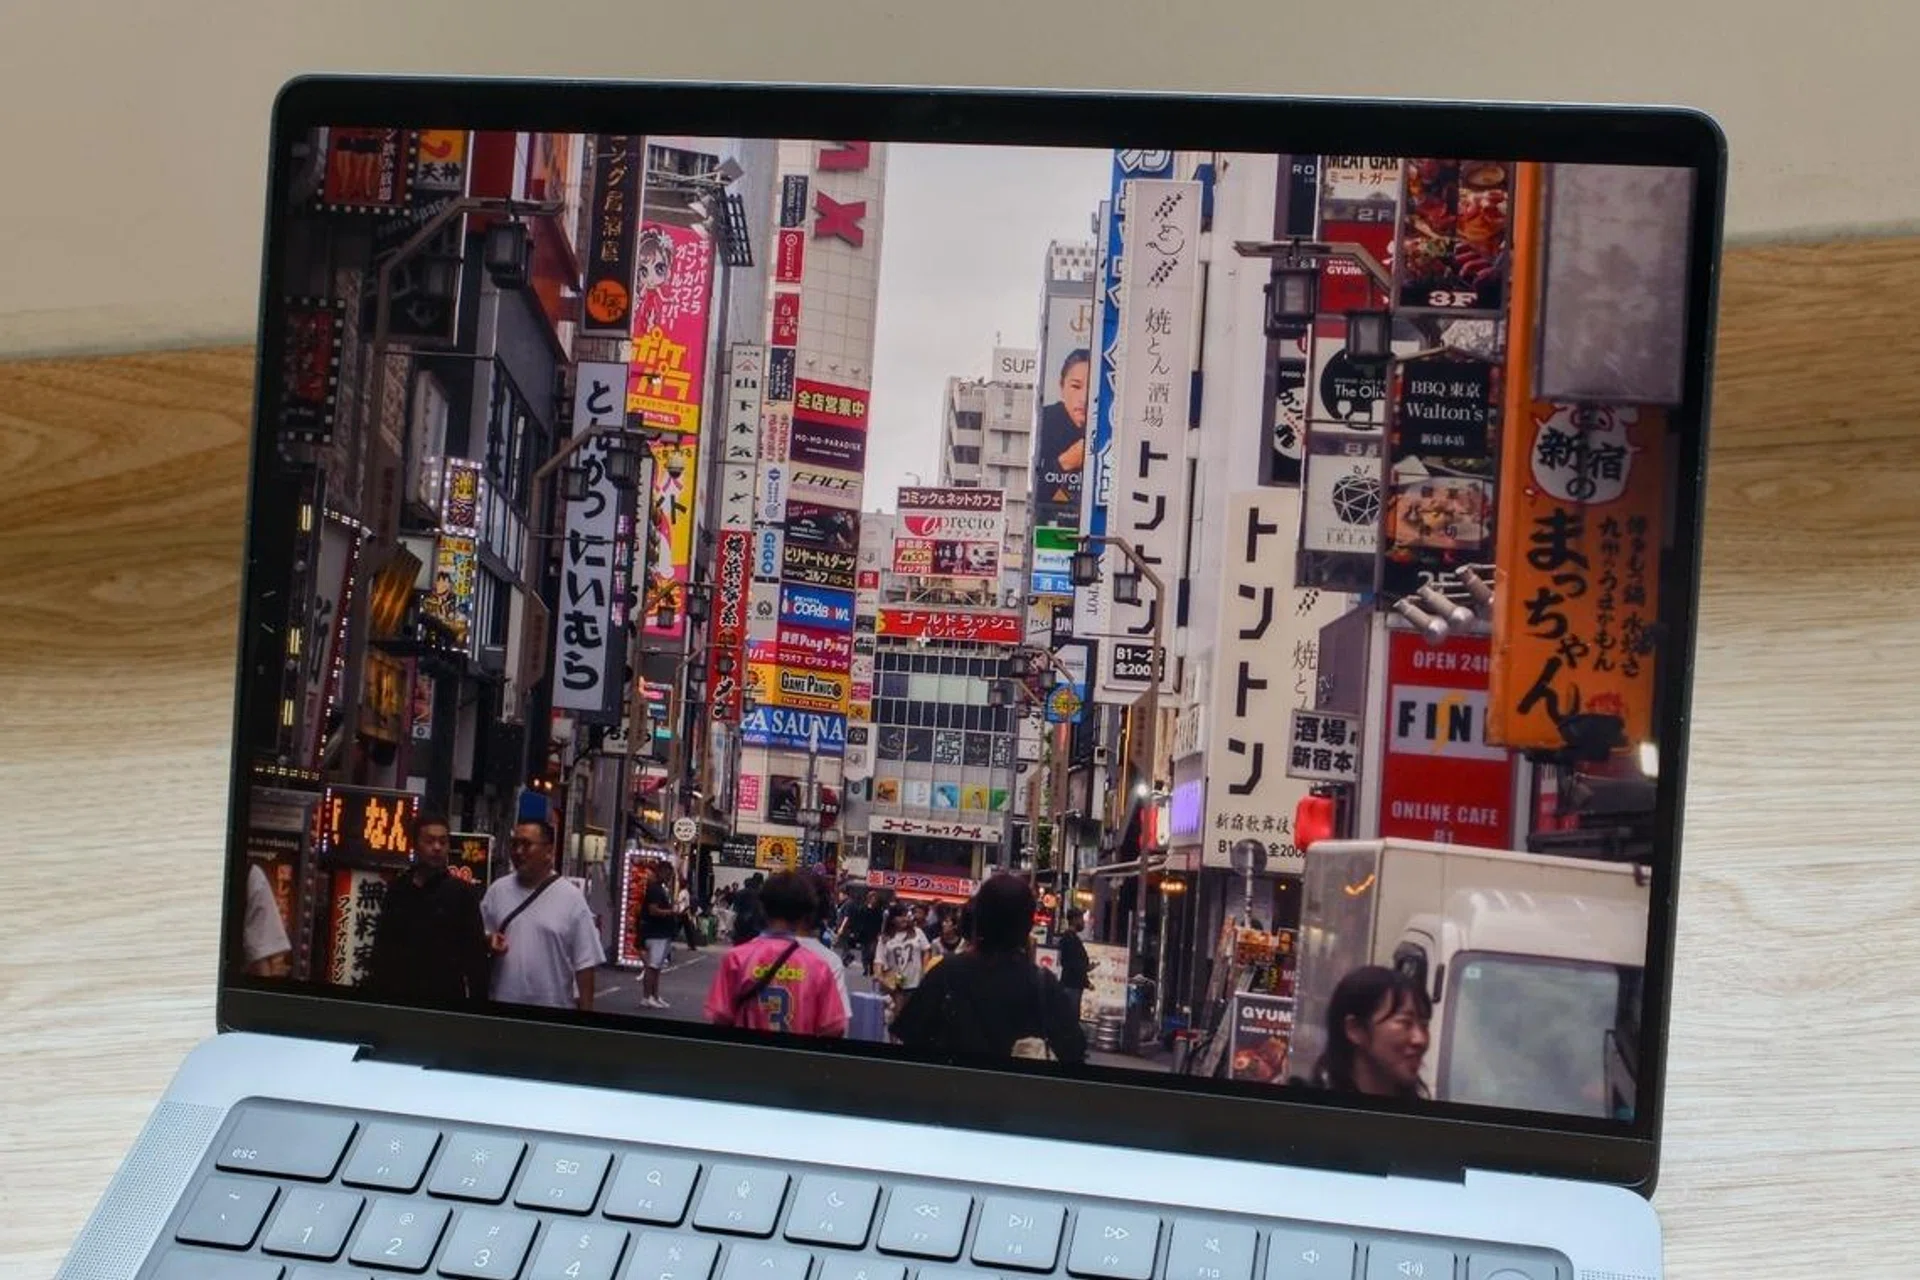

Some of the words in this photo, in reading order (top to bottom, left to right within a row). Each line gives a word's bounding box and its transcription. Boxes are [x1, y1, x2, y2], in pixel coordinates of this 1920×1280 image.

[601, 136, 627, 262] ング居酒屋
[1358, 208, 1391, 222] 2F
[680, 241, 698, 314] コンカフェ
[690, 240, 709, 315] キャバクラ
[667, 244, 687, 331] ガールズバー
[1428, 290, 1479, 307] 3F
[1002, 357, 1035, 374] SUP
[1145, 307, 1172, 427] 焼とん酒場
[1334, 384, 1357, 398] The
[1411, 380, 1446, 396] BBQ
[1449, 382, 1480, 398] 東京
[797, 391, 864, 417] 全店営業中
[1406, 402, 1484, 421] Walton's
[795, 433, 862, 451] MO-MO-PARADISE
[1421, 434, 1465, 446] 新宿本店
[1537, 427, 1627, 500] 新宿の
[792, 471, 860, 490] FACE
[900, 491, 1001, 507] コミック&ネットカフェ
[563, 380, 614, 691] とんかつにいむら
[1127, 441, 1169, 634] トントン
[761, 531, 776, 575] GiGO
[784, 546, 855, 570] ビリヤード&ダーツ
[900, 611, 1016, 630] ゴールドラッシュ
[1517, 507, 1591, 724] まっちゃん
[923, 626, 978, 638] ハンバーグ
[1228, 507, 1278, 795] トントン
[1413, 650, 1458, 671] OPEN
[782, 671, 805, 692] GAME
[772, 709, 845, 741] SAUNA
[1397, 700, 1490, 742] FIN
[1294, 716, 1356, 746] 酒場
[1292, 746, 1356, 774] 新宿本
[1392, 800, 1451, 823] ONLINE
[1457, 806, 1498, 827] CAFE
[364, 797, 408, 852] なん
[882, 819, 922, 832] コーヒー
[759, 986, 793, 1032] 3
[232, 1147, 257, 1160] esc
[638, 1199, 652, 1209] F4
[399, 1212, 414, 1225] @
[727, 1210, 741, 1220] F5
[301, 1225, 313, 1243] 1
[819, 1221, 833, 1231] F6
[385, 1237, 403, 1255] 2
[579, 1233, 591, 1249] $
[474, 1249, 491, 1267] 3
[566, 1261, 581, 1280] 4
[1197, 1267, 1220, 1278] F10
